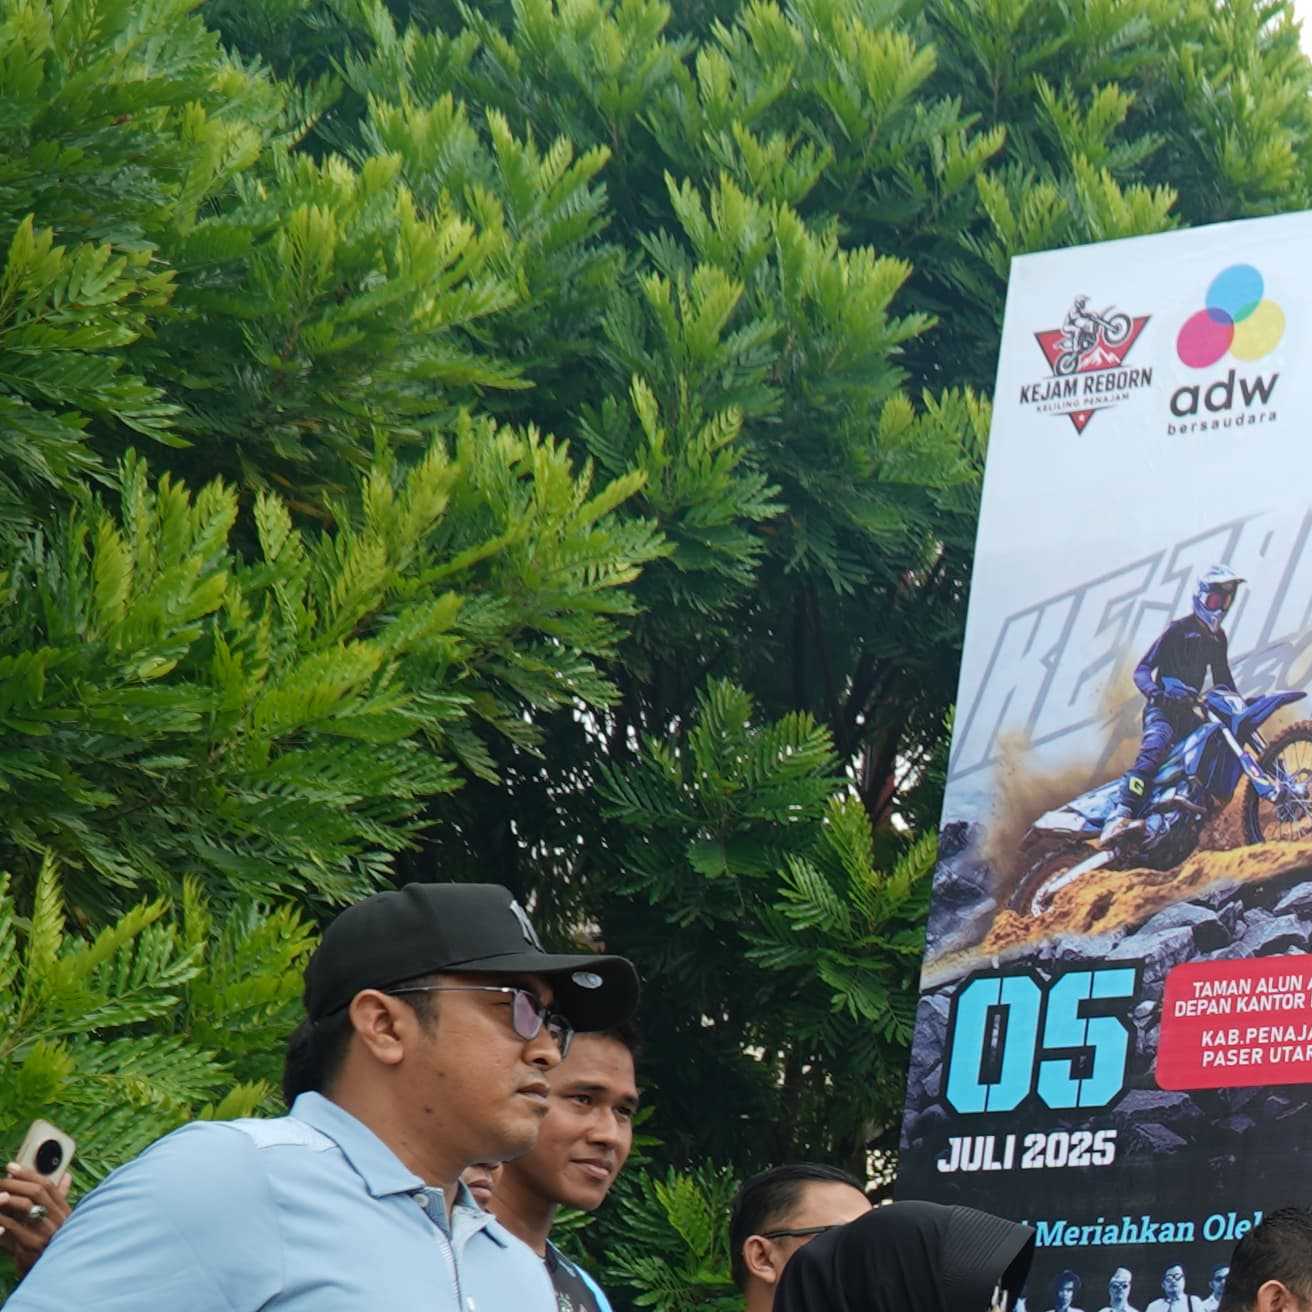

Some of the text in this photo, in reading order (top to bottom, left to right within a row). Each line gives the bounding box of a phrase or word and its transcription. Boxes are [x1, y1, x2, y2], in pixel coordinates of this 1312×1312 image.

[1019, 368, 1152, 404] KEJAM REBORN
[1170, 370, 1279, 417] adw
[1036, 399, 1080, 413] KELILING
[1168, 411, 1277, 435] bersaudara
[1193, 980, 1254, 999] TAMAN
[1258, 976, 1303, 995] ALUN
[1175, 997, 1231, 1017] DEPAN
[1236, 993, 1304, 1014] KANTOR
[945, 968, 1136, 1114] 05
[1202, 1047, 1262, 1068] PASER
[937, 1130, 1118, 1173] JULI 2025
[1035, 1216, 1194, 1247] Meriahkan
